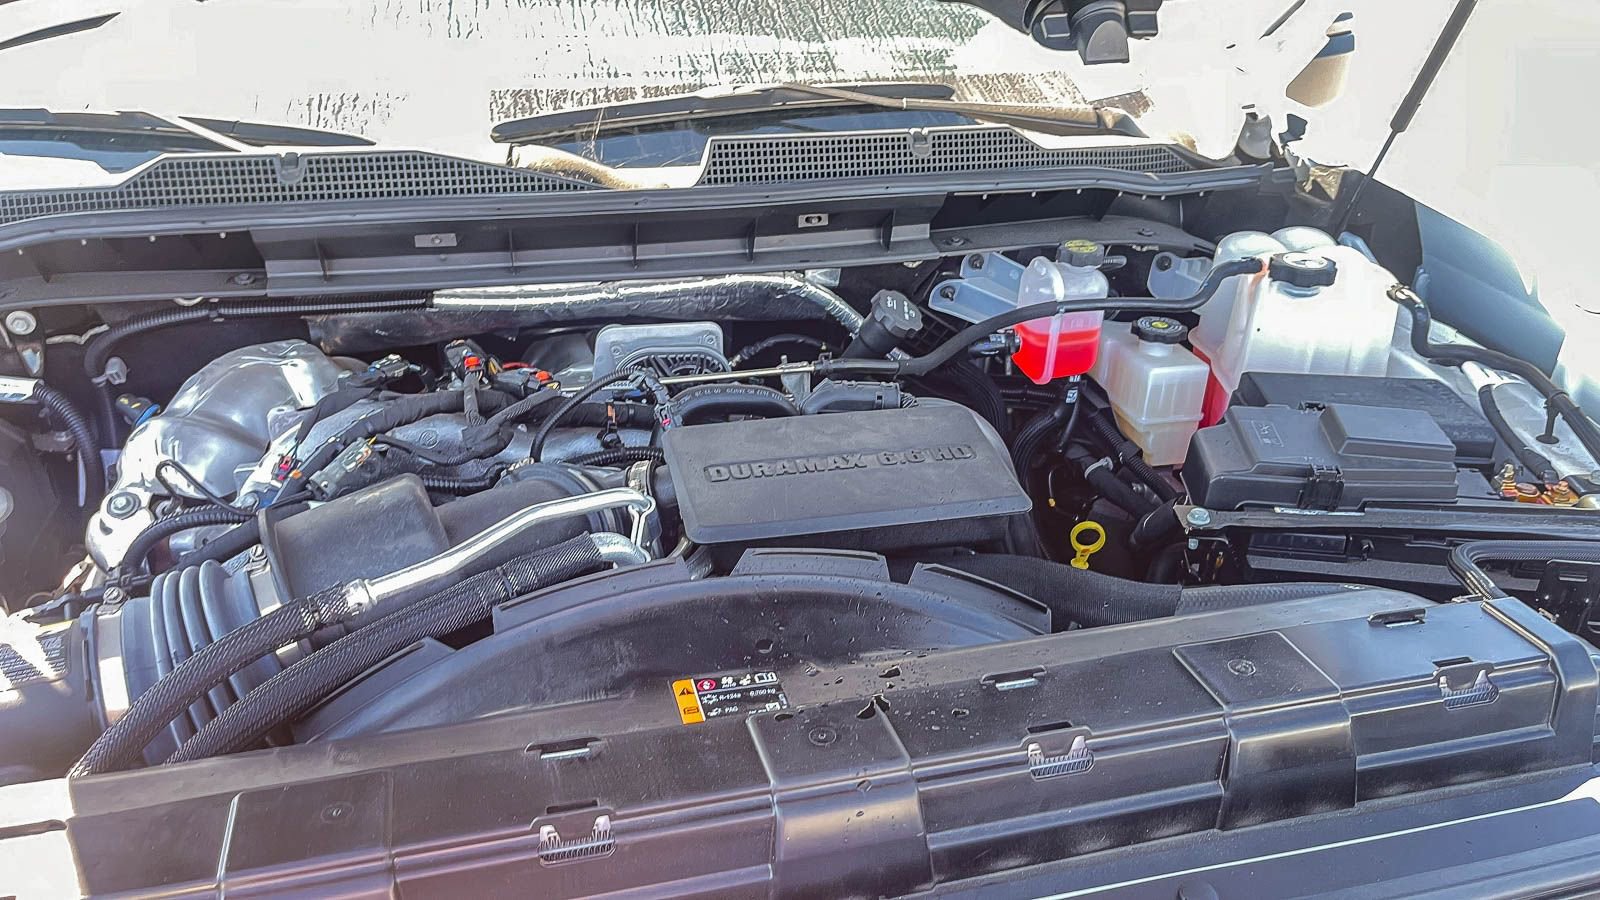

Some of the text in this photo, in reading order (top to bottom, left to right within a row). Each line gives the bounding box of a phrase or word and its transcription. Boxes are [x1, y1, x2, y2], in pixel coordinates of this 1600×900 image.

[703, 444, 976, 482] DURAMAX 6.6 HD
